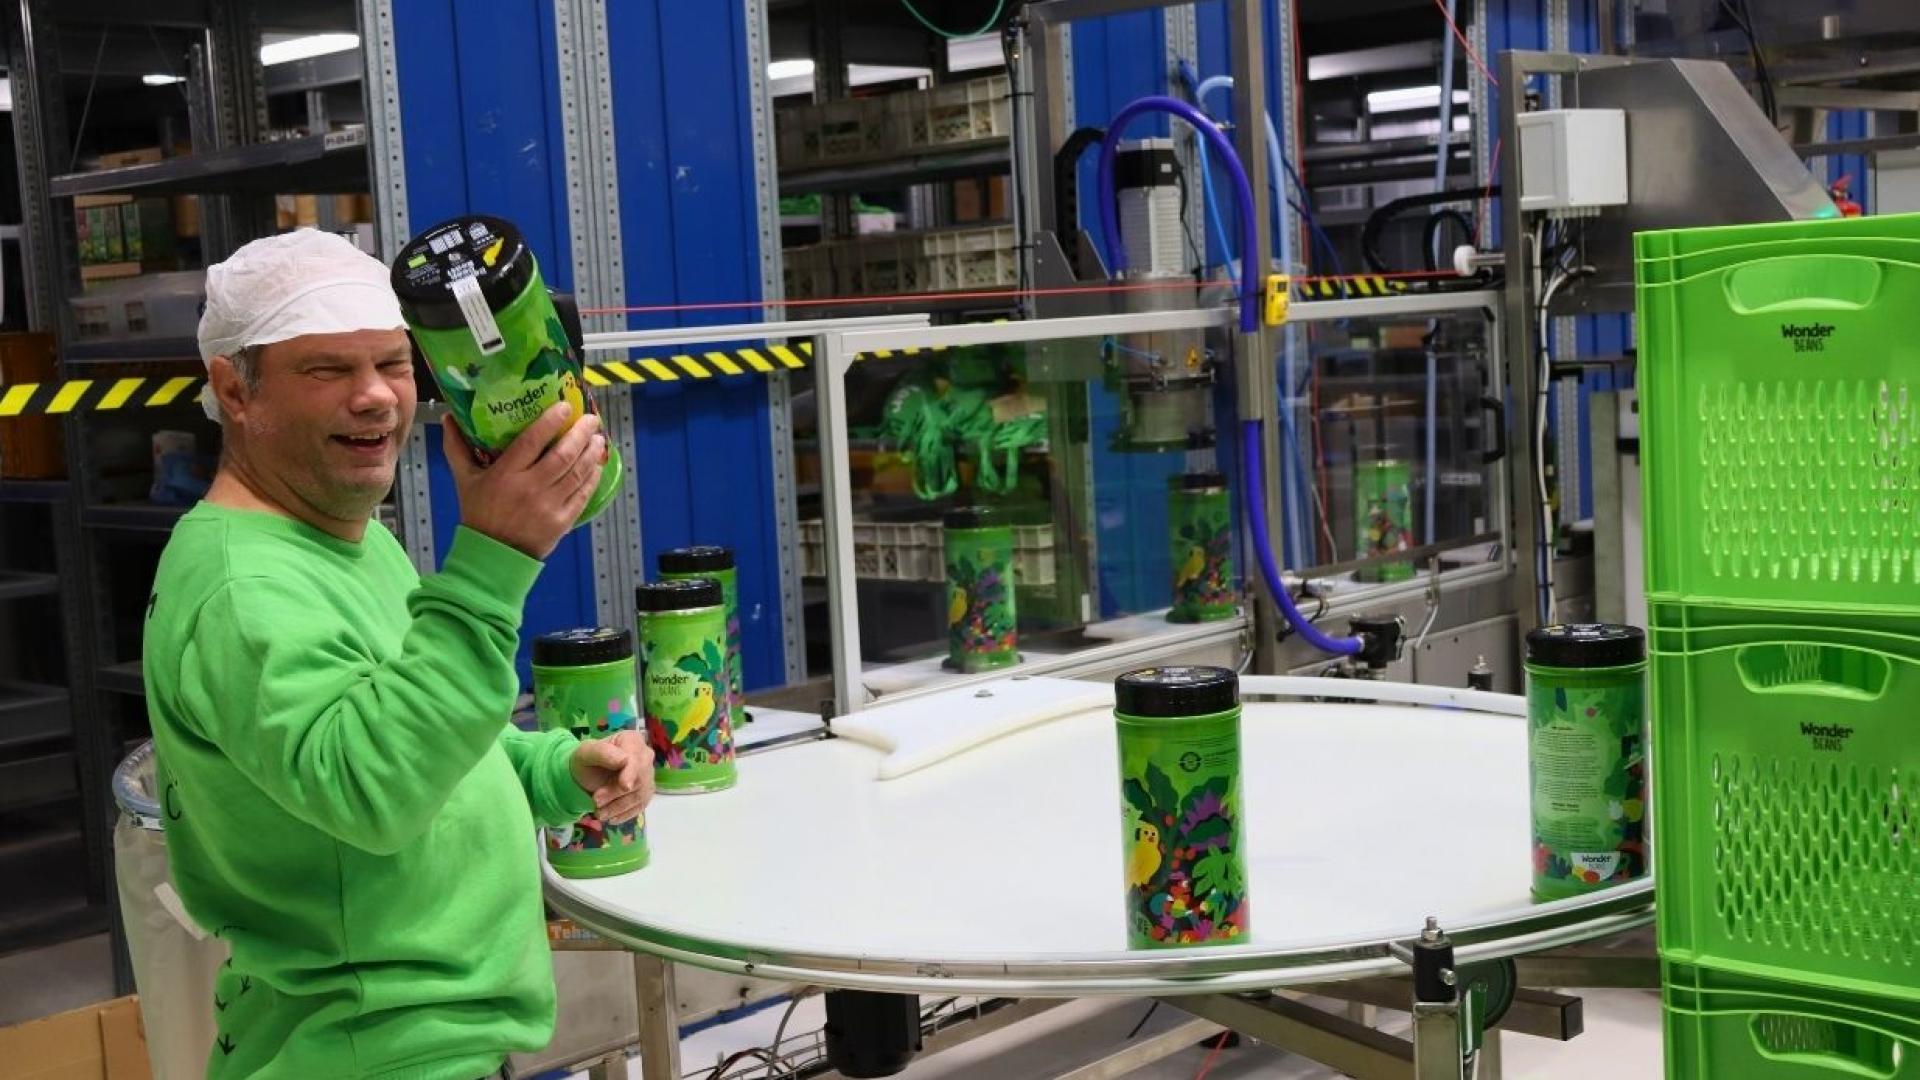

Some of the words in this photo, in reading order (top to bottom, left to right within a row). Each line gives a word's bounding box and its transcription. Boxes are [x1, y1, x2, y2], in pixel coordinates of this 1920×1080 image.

[1781, 322, 1836, 338] Wonder
[1794, 338, 1825, 353] BEANS
[488, 383, 548, 416] Wonder
[651, 672, 689, 686] Wonder
[1800, 721, 1854, 739] Wonder
[1813, 737, 1843, 752] BEANS
[1581, 853, 1613, 864] Wonder
